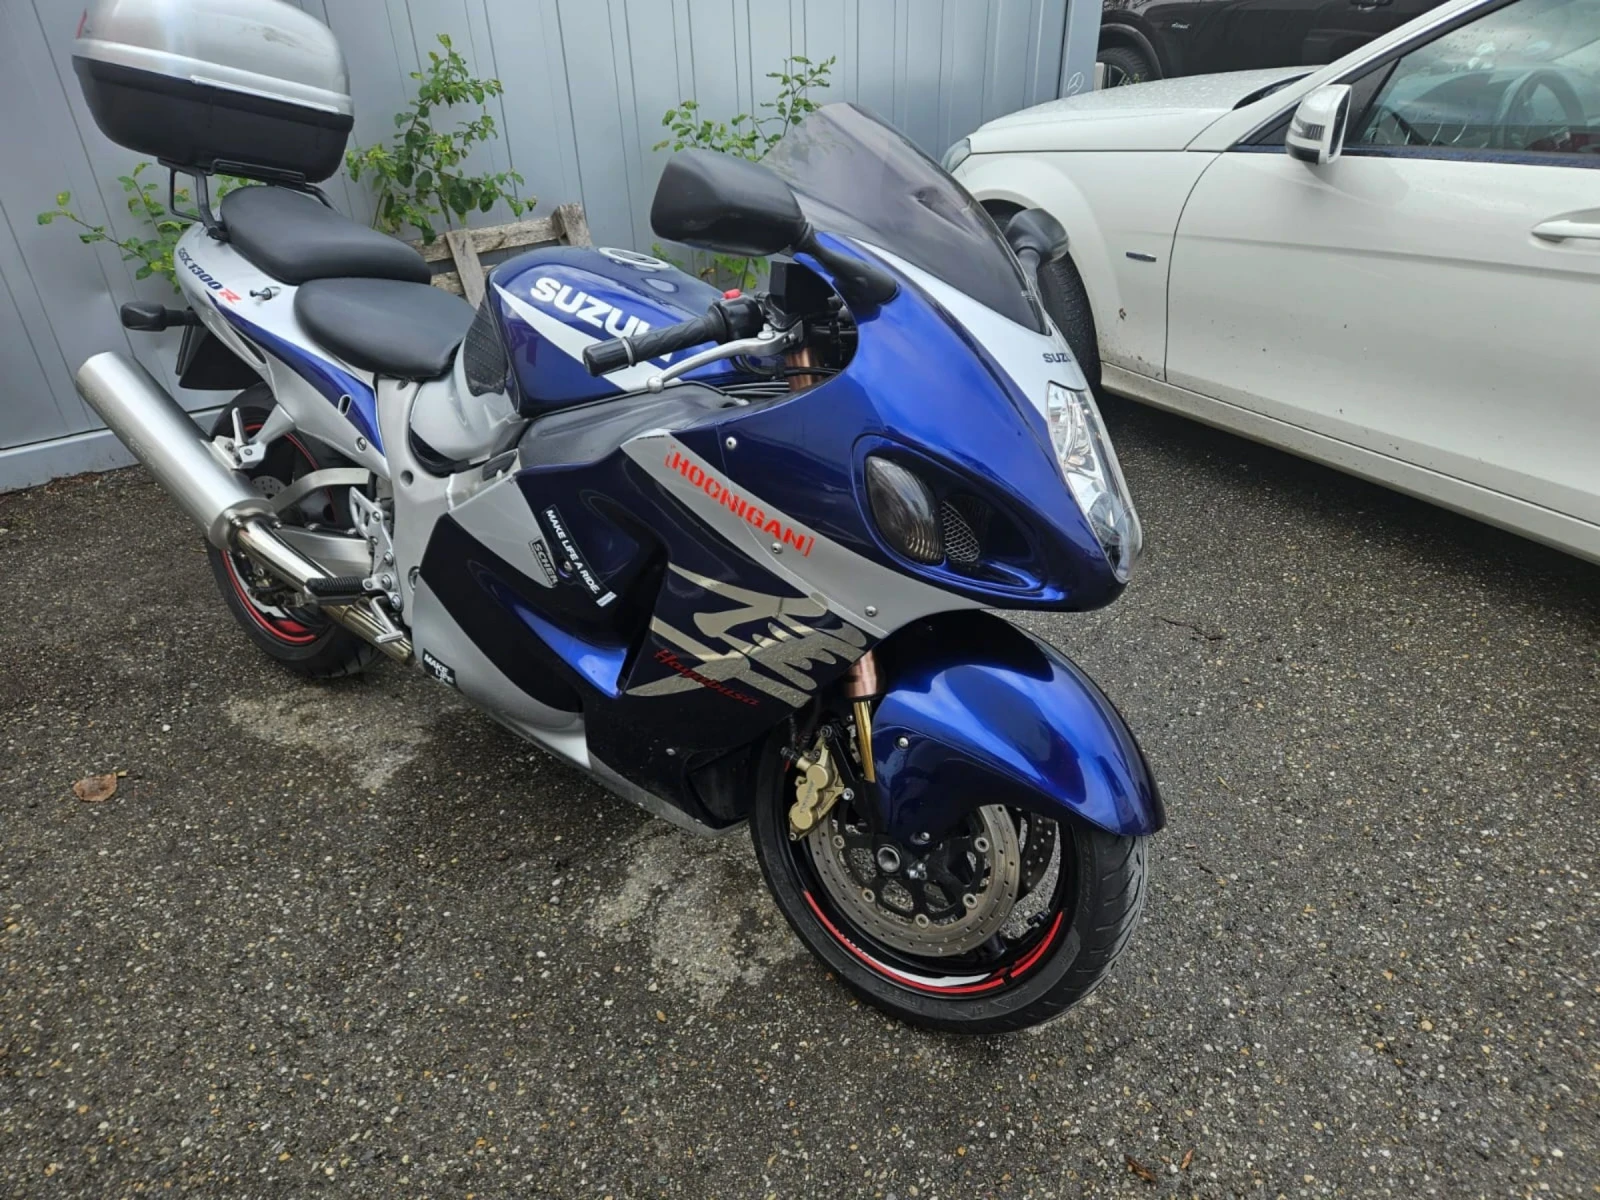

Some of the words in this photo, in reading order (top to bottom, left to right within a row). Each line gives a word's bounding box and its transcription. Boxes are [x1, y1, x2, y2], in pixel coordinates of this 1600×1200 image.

[530, 277, 672, 362] SUZU
[546, 509, 567, 539] MAKE
[561, 539, 579, 561] LIFE
[574, 561, 583, 571] A
[654, 648, 759, 705] Hayabusa
